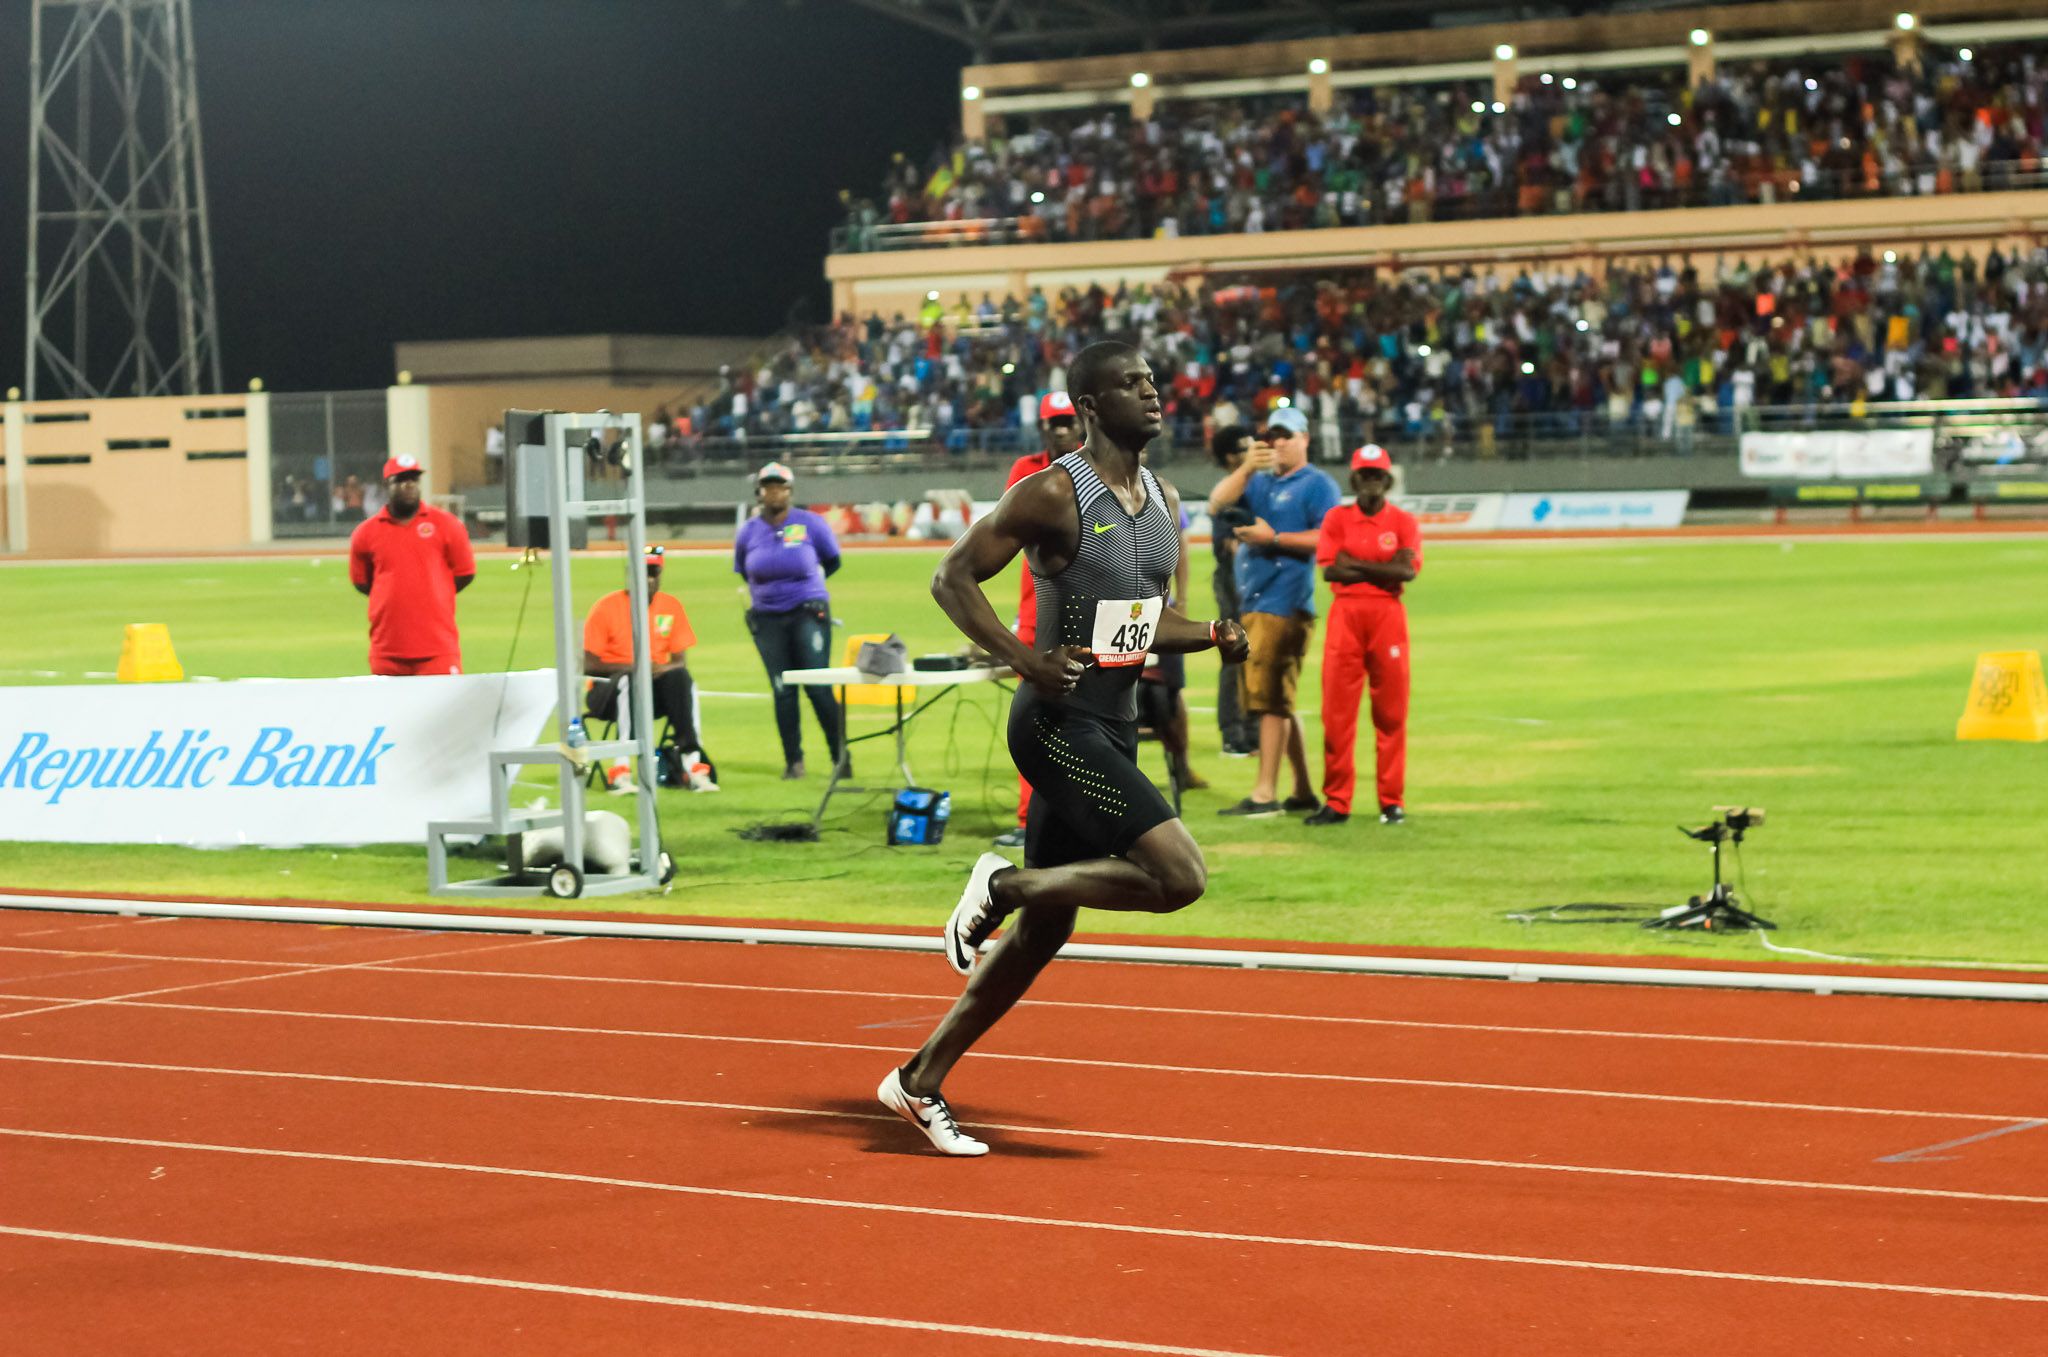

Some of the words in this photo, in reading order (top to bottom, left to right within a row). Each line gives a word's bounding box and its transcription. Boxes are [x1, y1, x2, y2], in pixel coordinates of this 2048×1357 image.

[1111, 622, 1149, 652] 436
[0, 729, 229, 804] Republic
[227, 726, 396, 788] Bank
